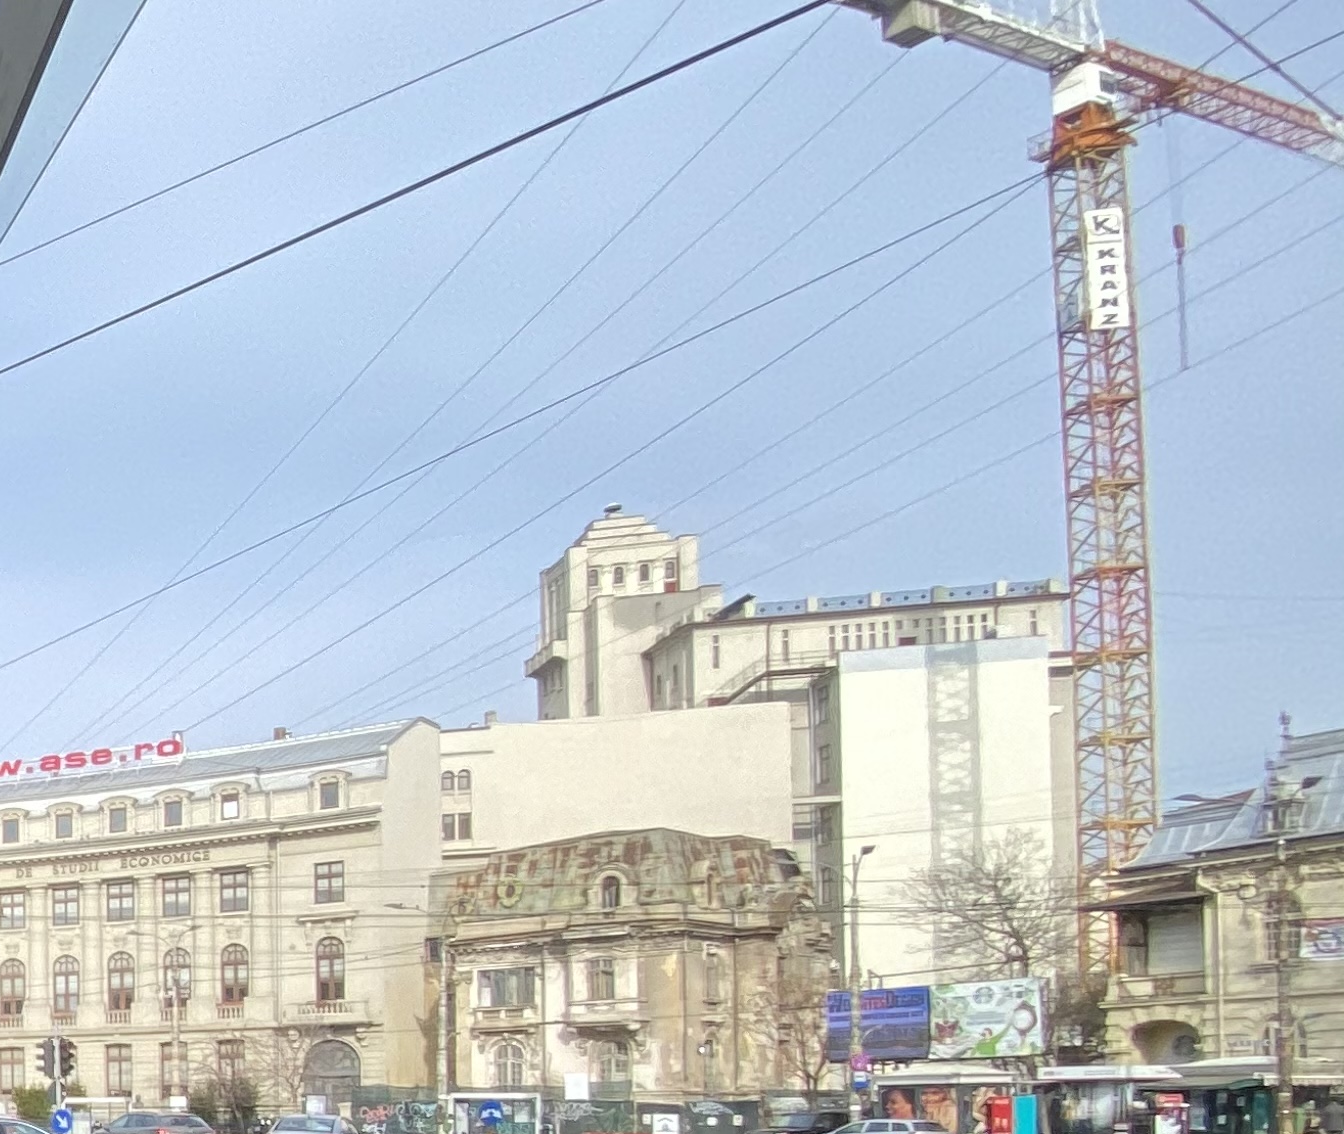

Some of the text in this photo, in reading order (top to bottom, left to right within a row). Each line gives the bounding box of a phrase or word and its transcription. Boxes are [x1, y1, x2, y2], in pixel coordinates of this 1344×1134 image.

[15, 866, 33, 879] DE
[52, 861, 100, 876] STUDII
[120, 850, 211, 870] ECONOMICE
